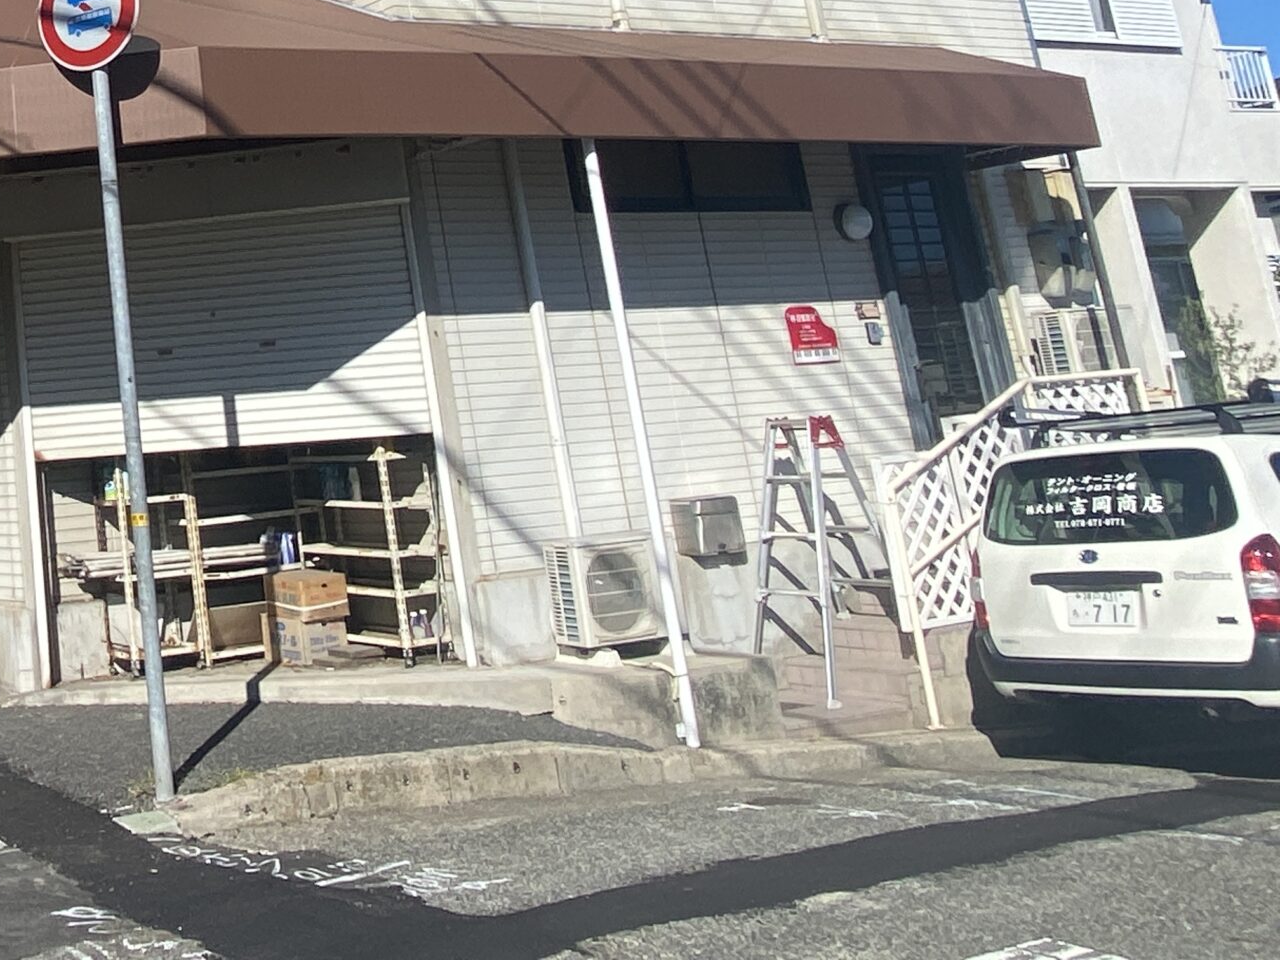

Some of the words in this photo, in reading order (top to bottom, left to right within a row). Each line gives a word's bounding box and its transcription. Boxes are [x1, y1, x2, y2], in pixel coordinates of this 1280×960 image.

[1025, 503, 1065, 515] 株式会社
[1069, 492, 1165, 515] 吉岡商店
